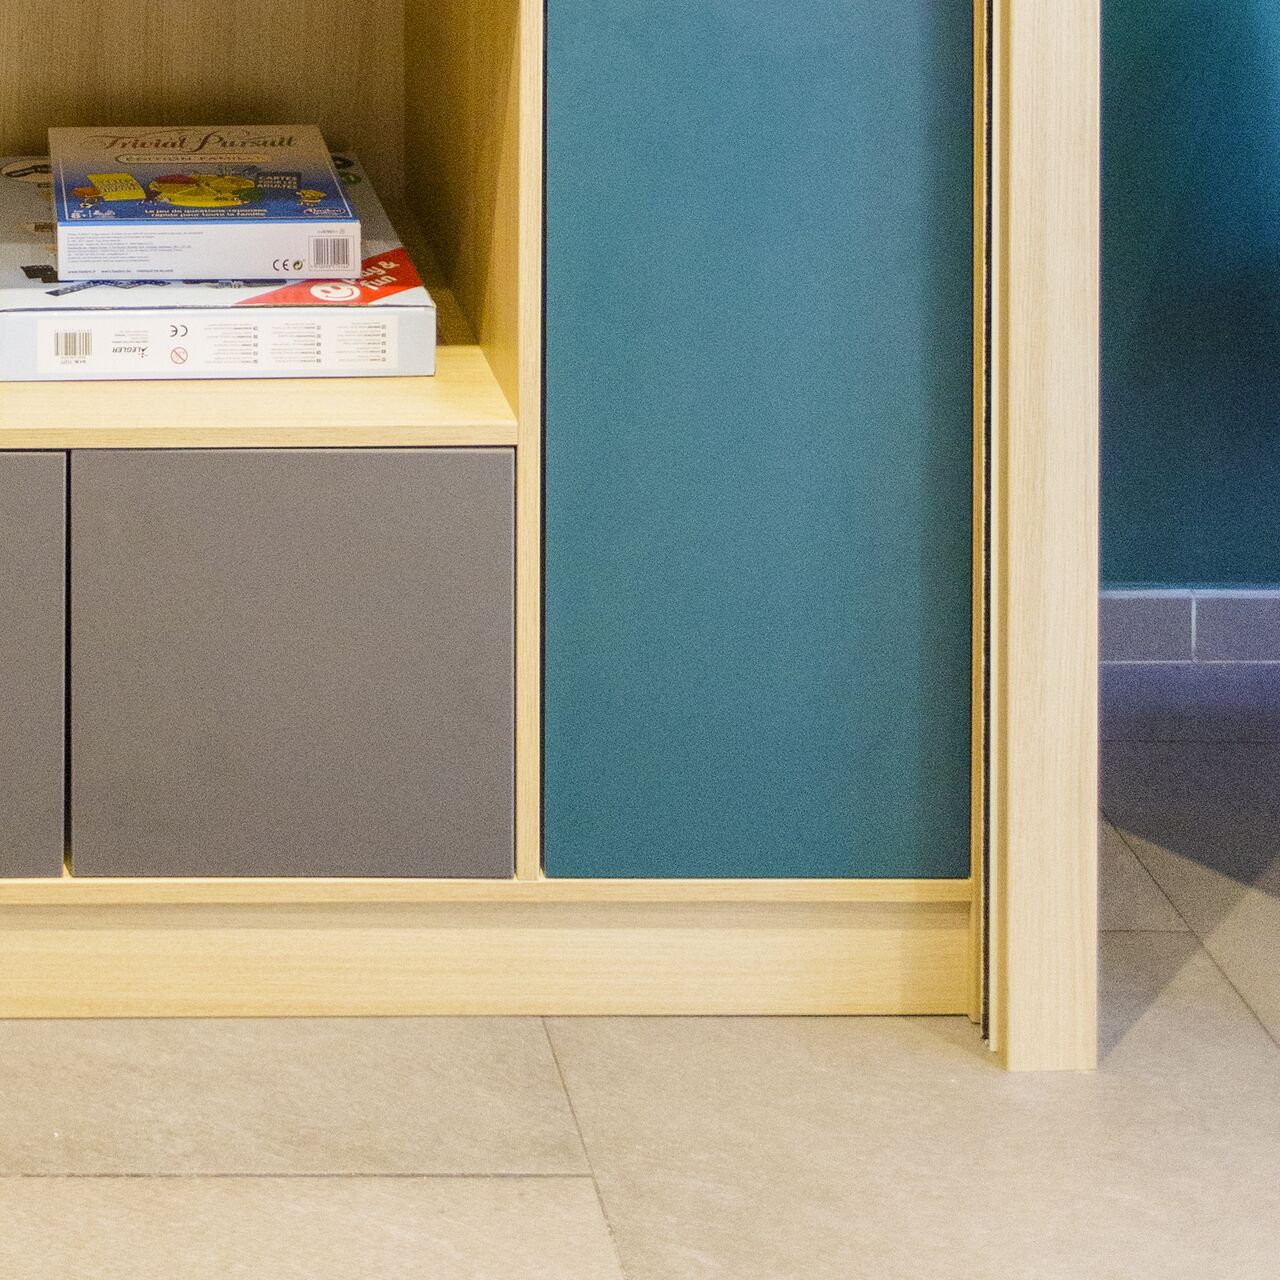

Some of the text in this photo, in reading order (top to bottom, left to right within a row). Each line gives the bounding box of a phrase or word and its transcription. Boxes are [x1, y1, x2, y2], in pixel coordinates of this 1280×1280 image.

[94, 129, 297, 153] Trivial Pursuit
[378, 260, 400, 269] &
[360, 274, 398, 291] fun
[111, 346, 141, 354] LEGLER
